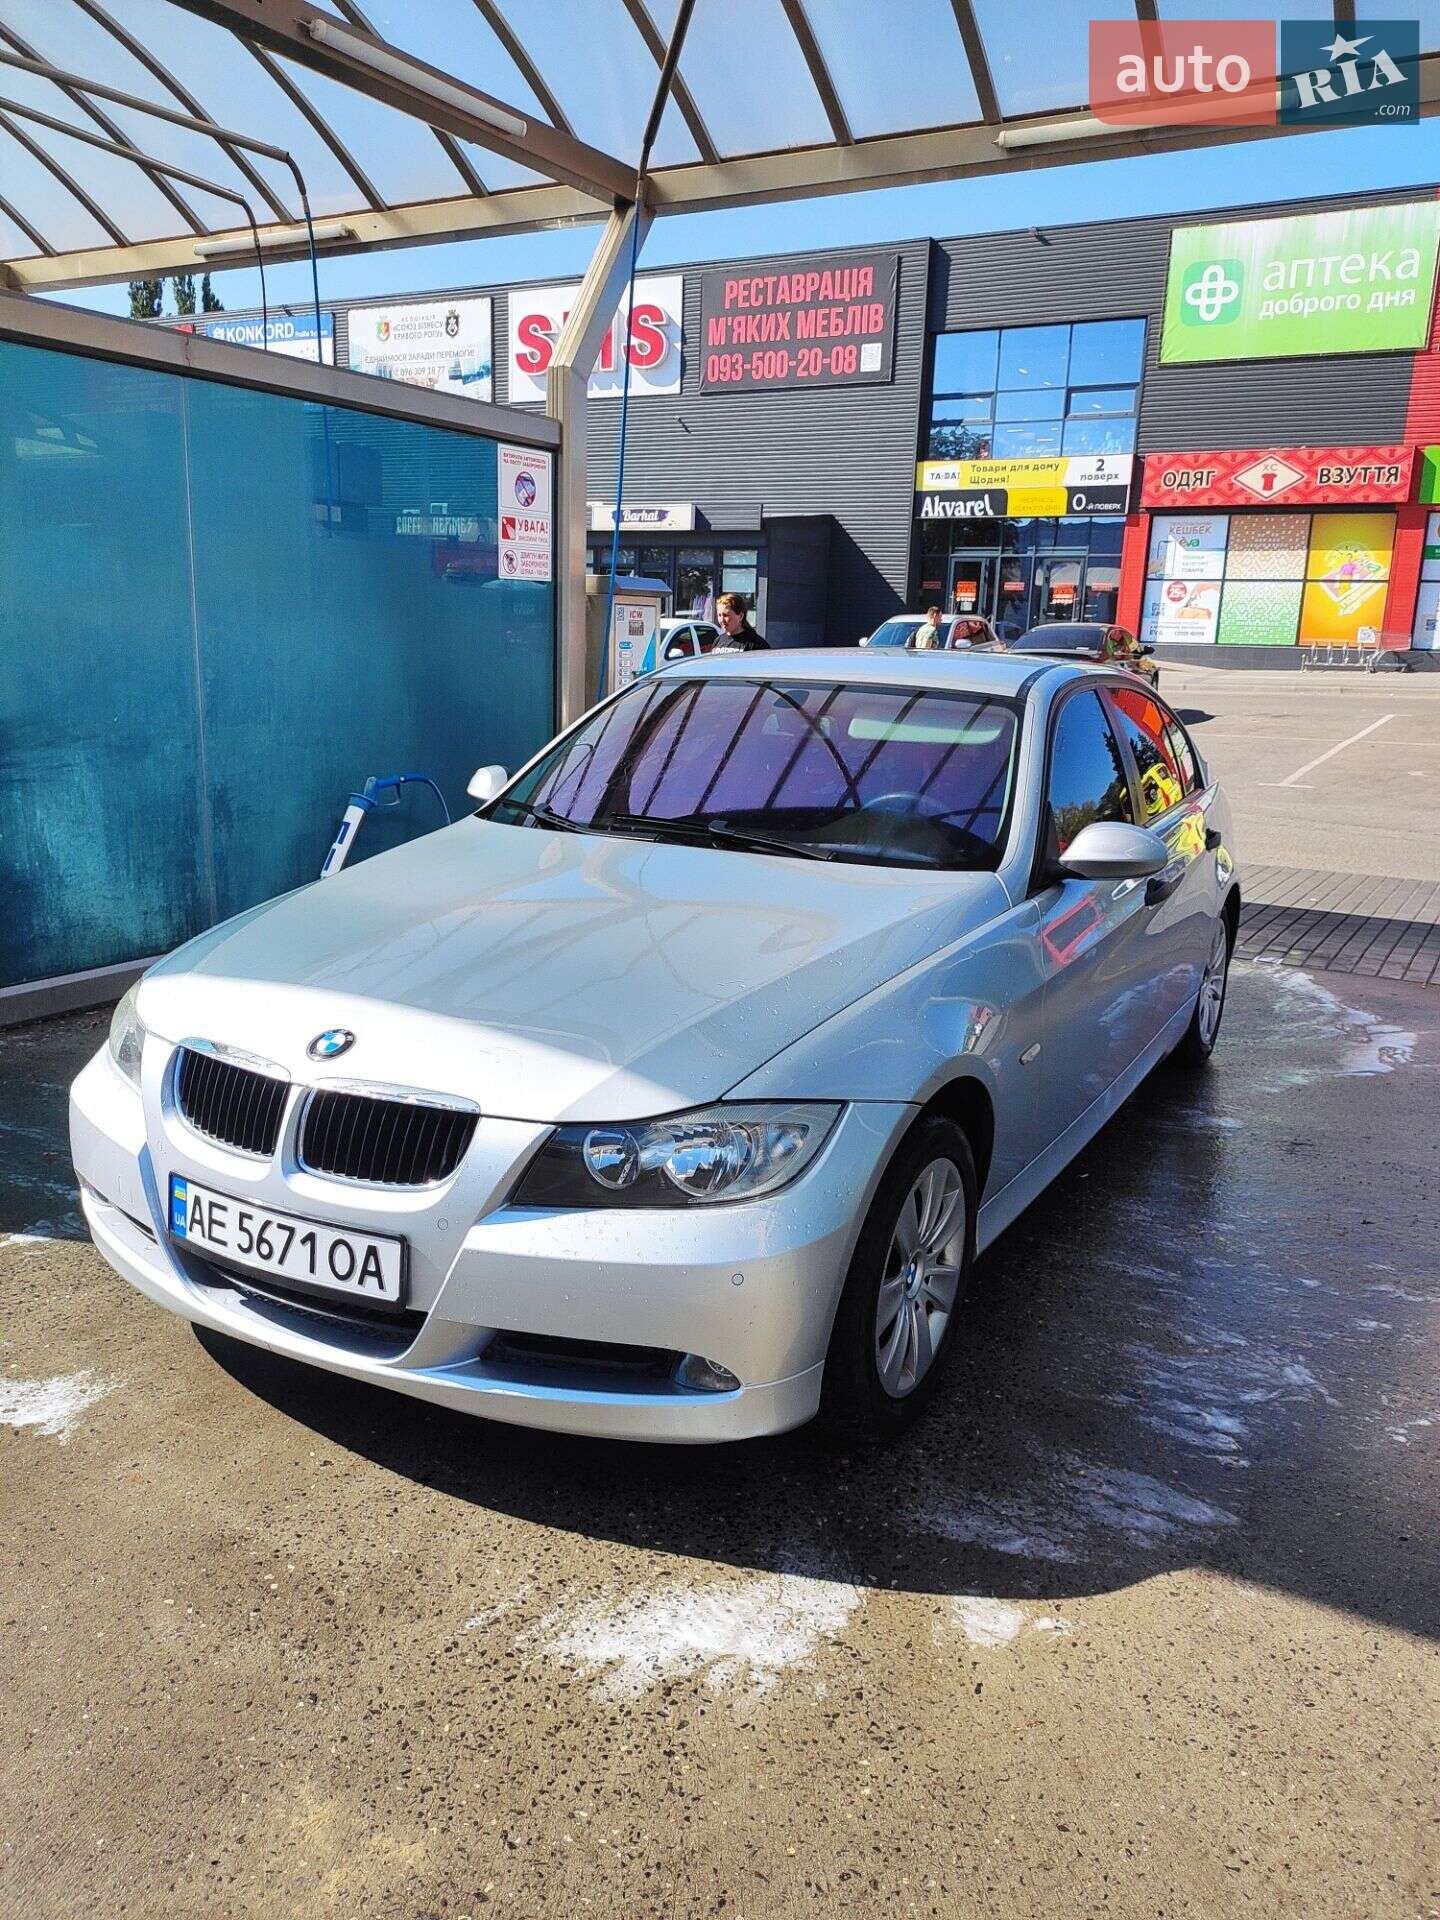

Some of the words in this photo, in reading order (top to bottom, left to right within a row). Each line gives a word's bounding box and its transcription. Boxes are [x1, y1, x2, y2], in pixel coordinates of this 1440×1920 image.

[1263, 248, 1421, 291] аптека
[724, 266, 874, 310] РЕСТАВРАЦІЯ
[1259, 292, 1361, 320] доброго
[1366, 288, 1416, 313] дня
[226, 321, 295, 342] KONKORD
[707, 311, 792, 346] М'ЯКИХ
[797, 303, 884, 339] МЕБЛІВ
[707, 344, 857, 383] 093-500-20-08
[970, 464, 1007, 474] Товари
[1009, 464, 1029, 472] для
[1032, 463, 1060, 472] дому
[1095, 458, 1105, 473] 2
[1317, 465, 1400, 487] ВЗУТТЯ
[969, 475, 1010, 485] Щодня!
[1080, 472, 1120, 482] поверх
[1162, 470, 1216, 492] ОДЯГ
[920, 493, 994, 517] Akvarel
[517, 519, 548, 534] УВАГА!
[1168, 524, 1213, 536] КЕШБЕК
[175, 1213, 187, 1228] UA
[189, 1194, 229, 1248] AE
[236, 1210, 317, 1275] 5671
[327, 1238, 386, 1291] OA
